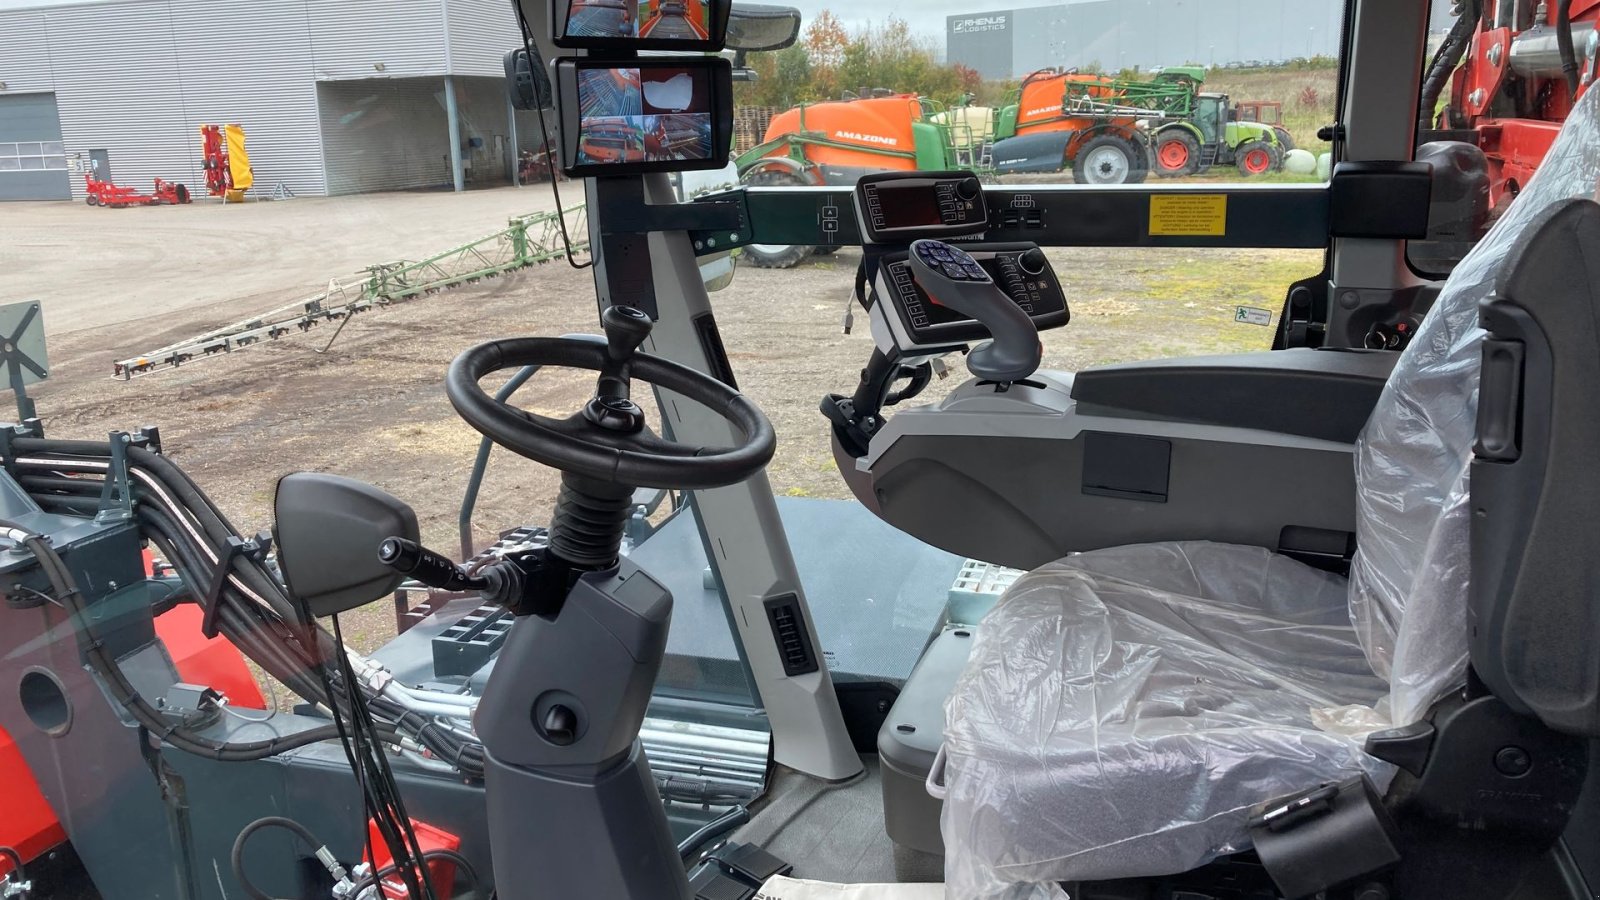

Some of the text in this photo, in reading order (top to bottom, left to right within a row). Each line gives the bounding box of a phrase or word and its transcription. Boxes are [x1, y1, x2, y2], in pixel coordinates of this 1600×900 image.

[964, 16, 1006, 27] RHENUS
[964, 24, 1006, 33] LOGISTICS
[835, 130, 897, 145] AMAZONE
